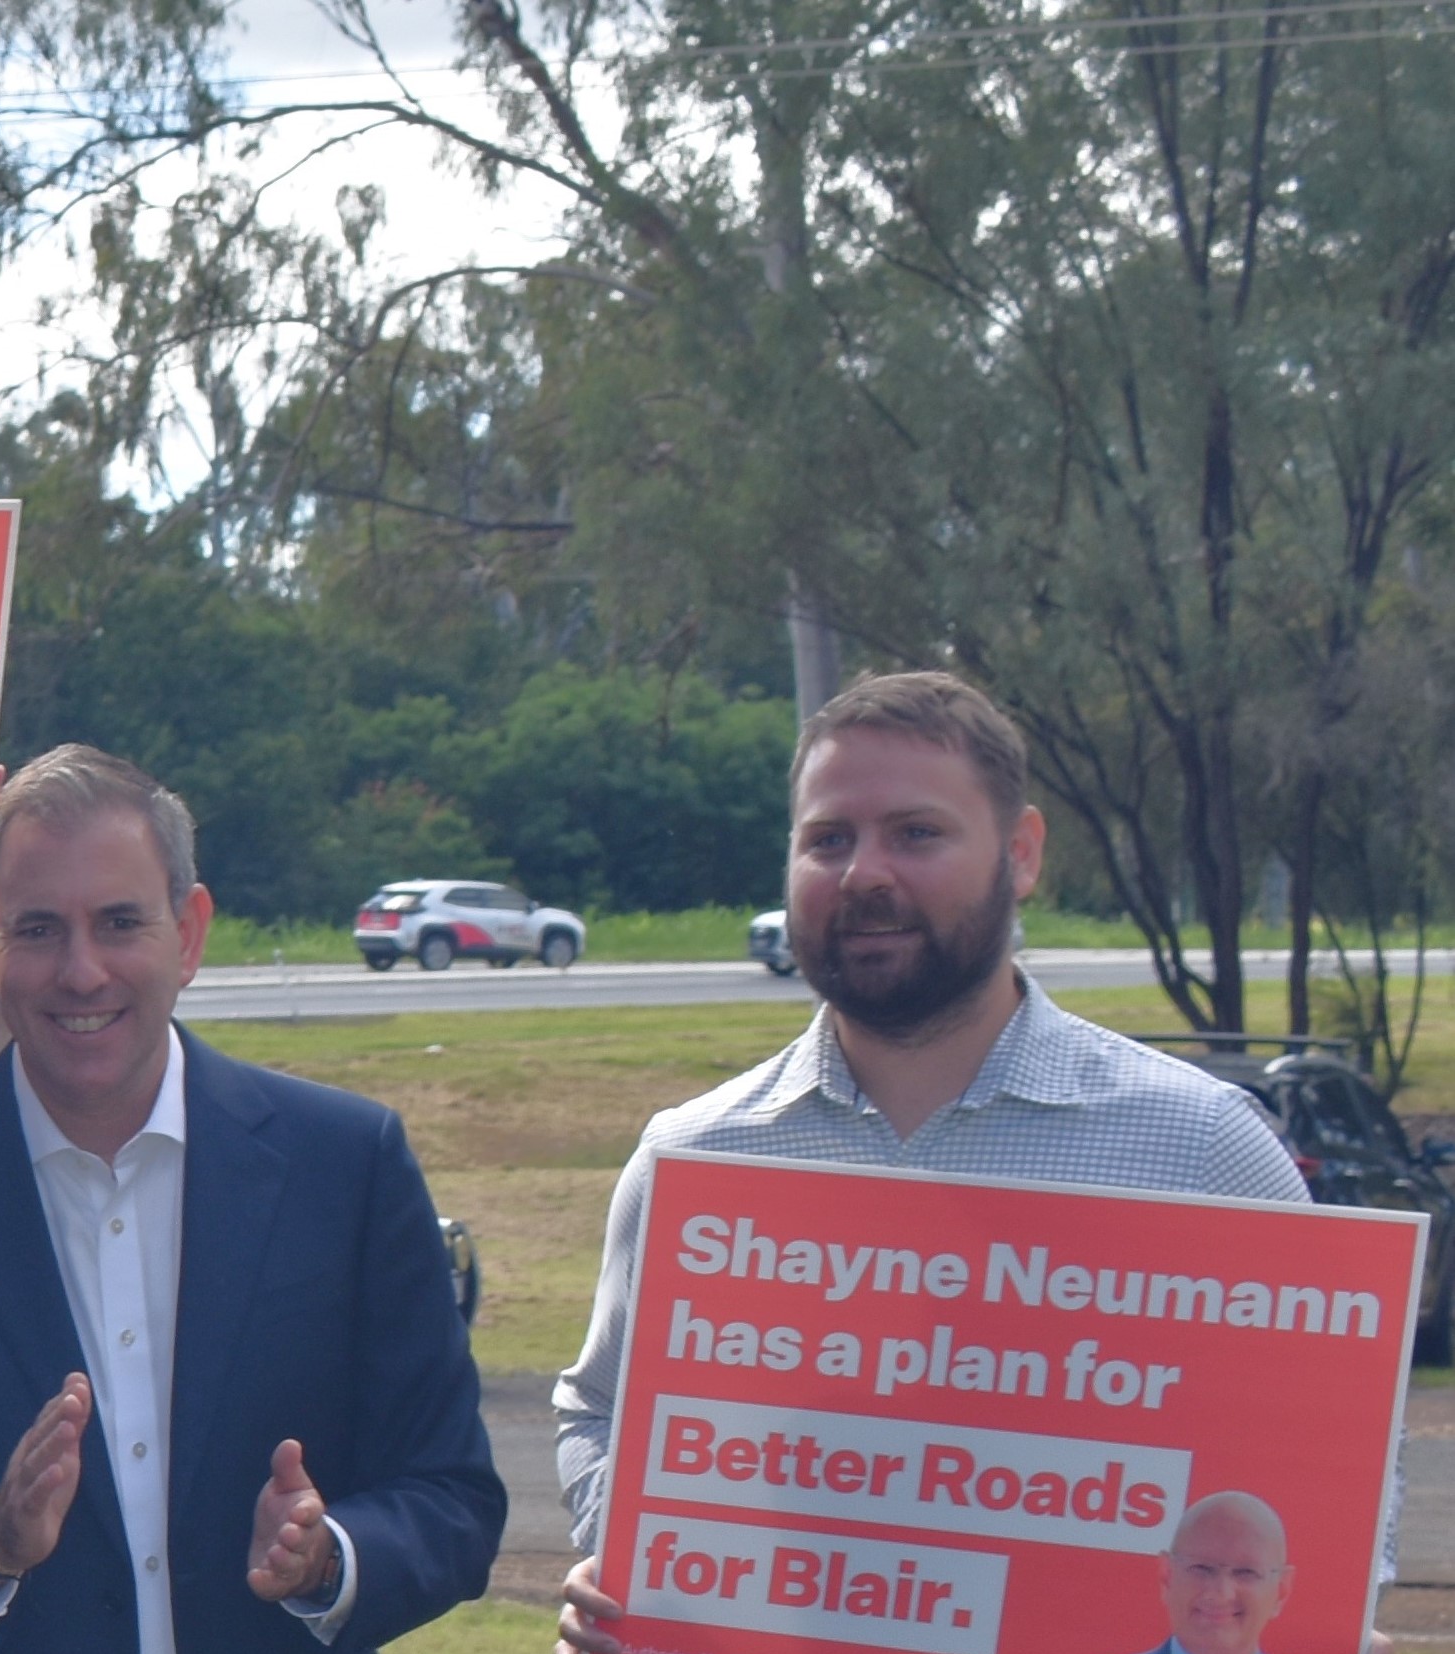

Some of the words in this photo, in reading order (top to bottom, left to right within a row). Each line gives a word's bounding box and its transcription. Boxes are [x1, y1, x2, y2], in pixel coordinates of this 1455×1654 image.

[678, 1214, 970, 1302] Shayne
[983, 1242, 1381, 1338] Neumann
[666, 1299, 803, 1371] has
[816, 1332, 862, 1378] a
[875, 1324, 1049, 1397] plan
[1064, 1339, 1182, 1409] for
[662, 1416, 904, 1495] Better
[920, 1445, 1165, 1527] Roads
[646, 1531, 755, 1598] for
[767, 1546, 972, 1628] Blair.
